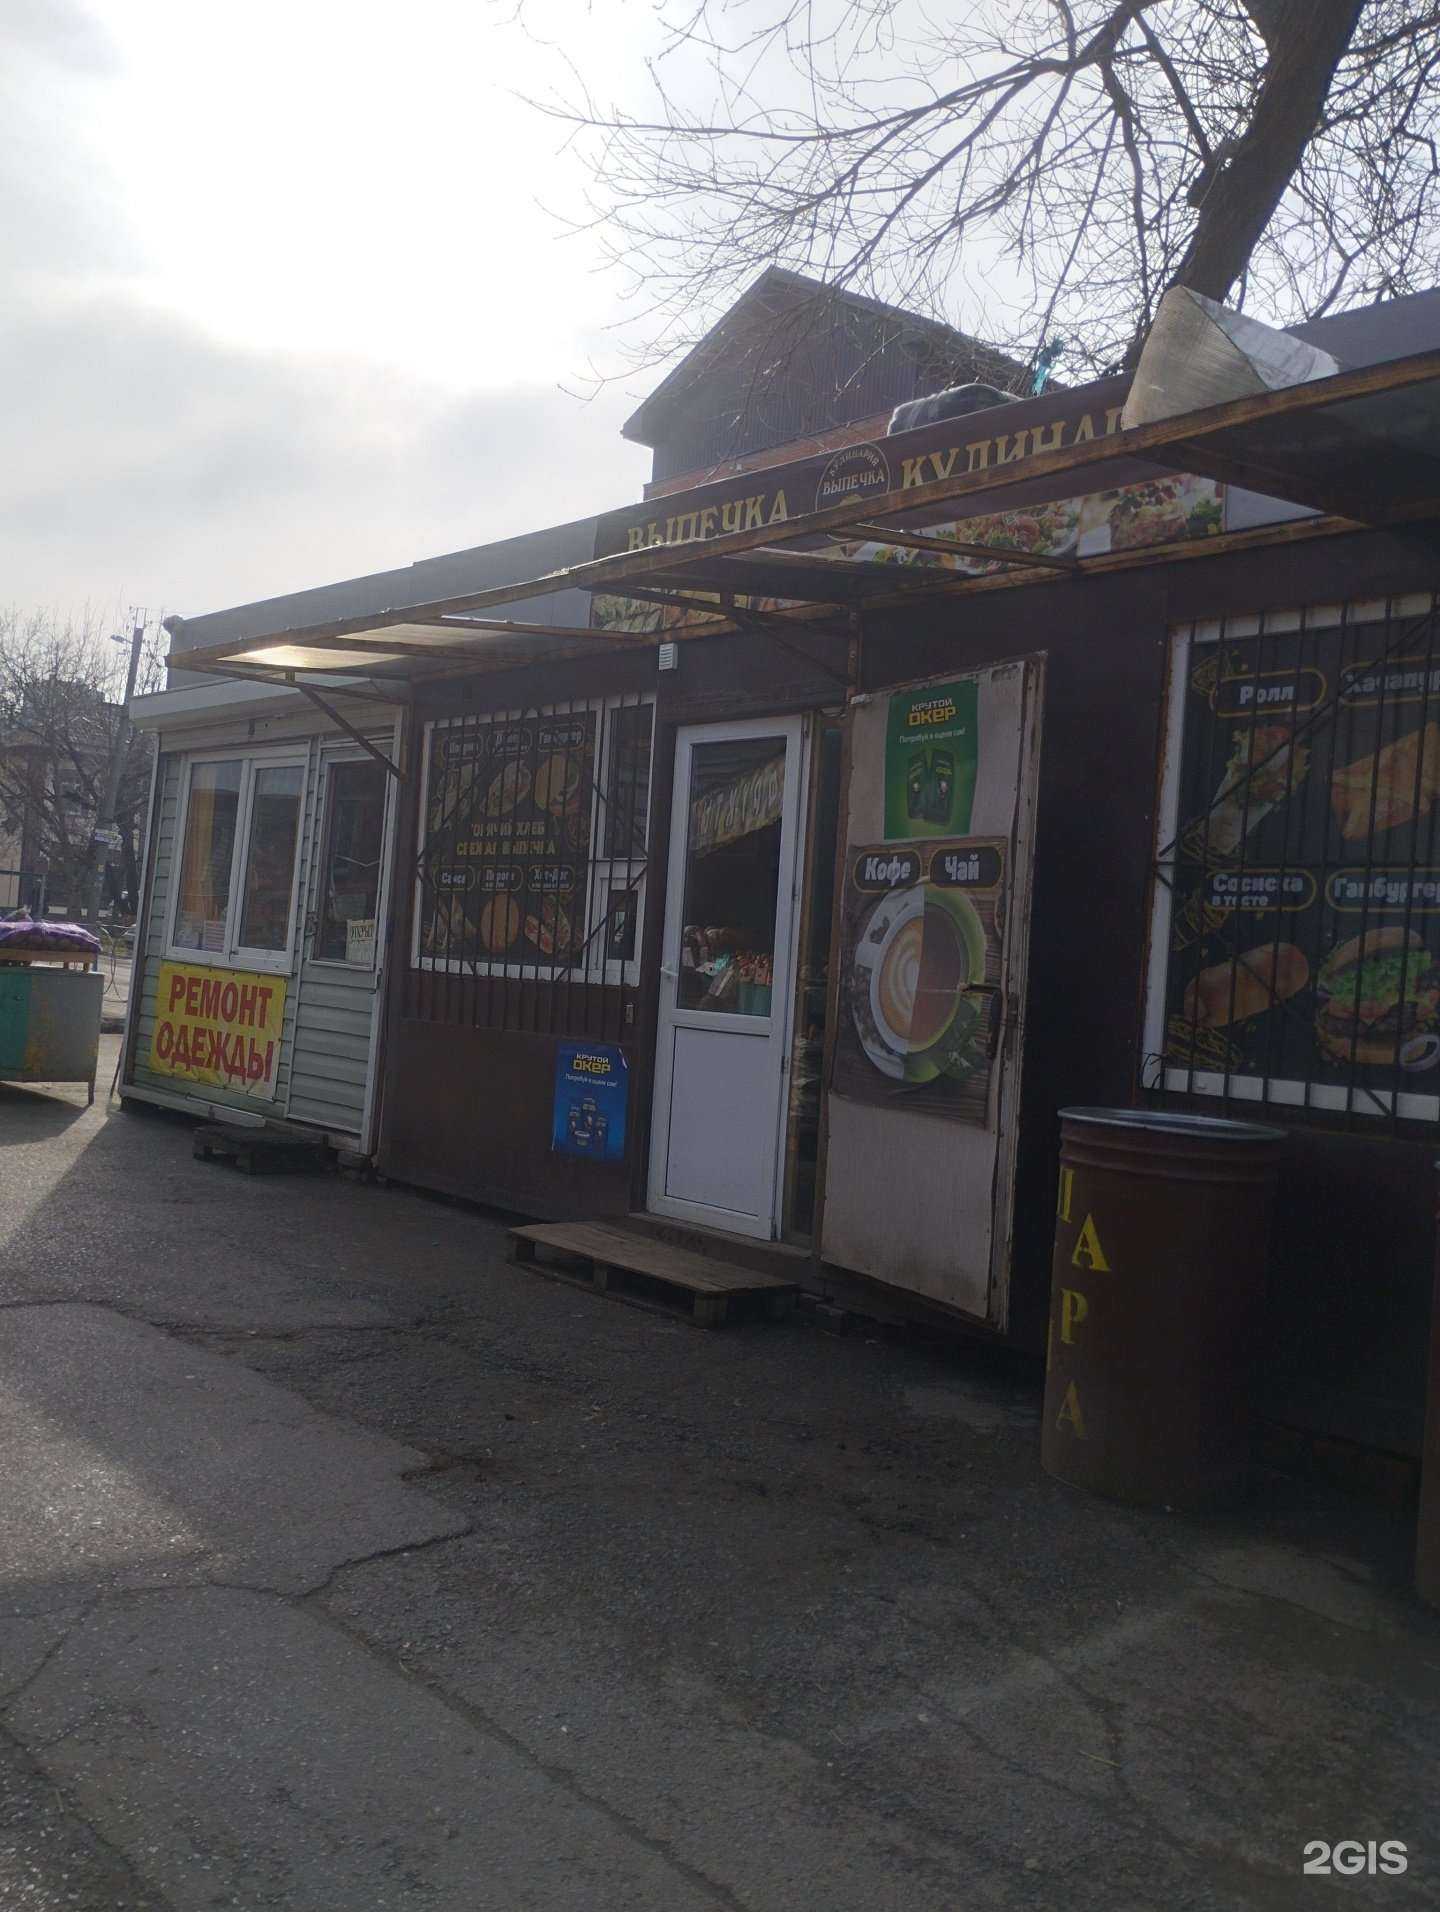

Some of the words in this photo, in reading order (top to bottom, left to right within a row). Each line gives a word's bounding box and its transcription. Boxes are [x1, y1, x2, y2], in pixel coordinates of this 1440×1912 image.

[822, 468, 886, 496] ВЫПЕЧКА
[627, 488, 789, 552] ВЫПЕЧКА
[911, 696, 954, 712] КРУТОЙ
[1238, 684, 1296, 705] Ролл
[864, 855, 912, 886] Кофе
[944, 853, 980, 881] Чай
[169, 974, 273, 1029] РЕМОНТ
[156, 1020, 274, 1086] ОДЕЖДЫ
[576, 1052, 609, 1065] КРУТОЙ
